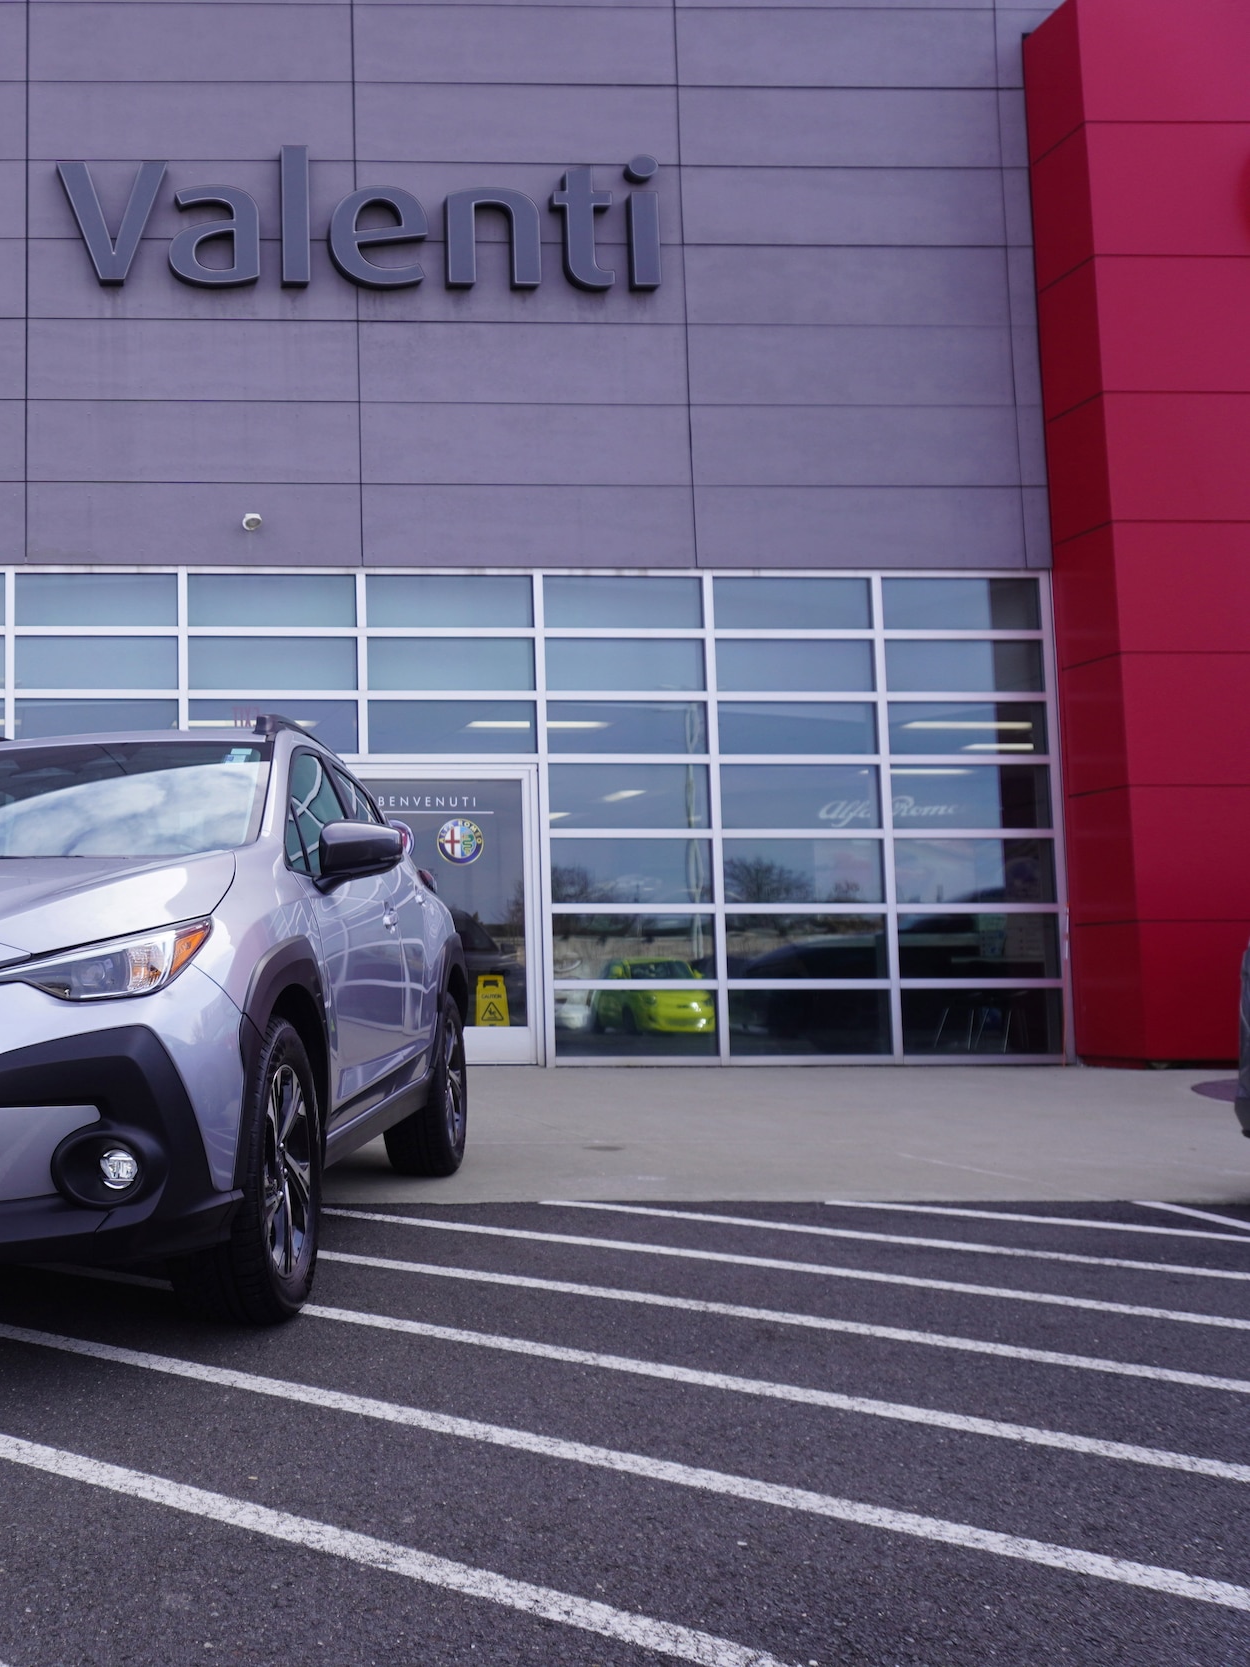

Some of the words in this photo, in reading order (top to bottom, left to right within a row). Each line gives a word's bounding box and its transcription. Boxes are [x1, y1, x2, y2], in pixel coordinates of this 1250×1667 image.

[56, 145, 662, 291] Valenti
[378, 796, 477, 807] BENVENUTI
[818, 800, 871, 827] Alfa
[892, 795, 966, 817] Rome
